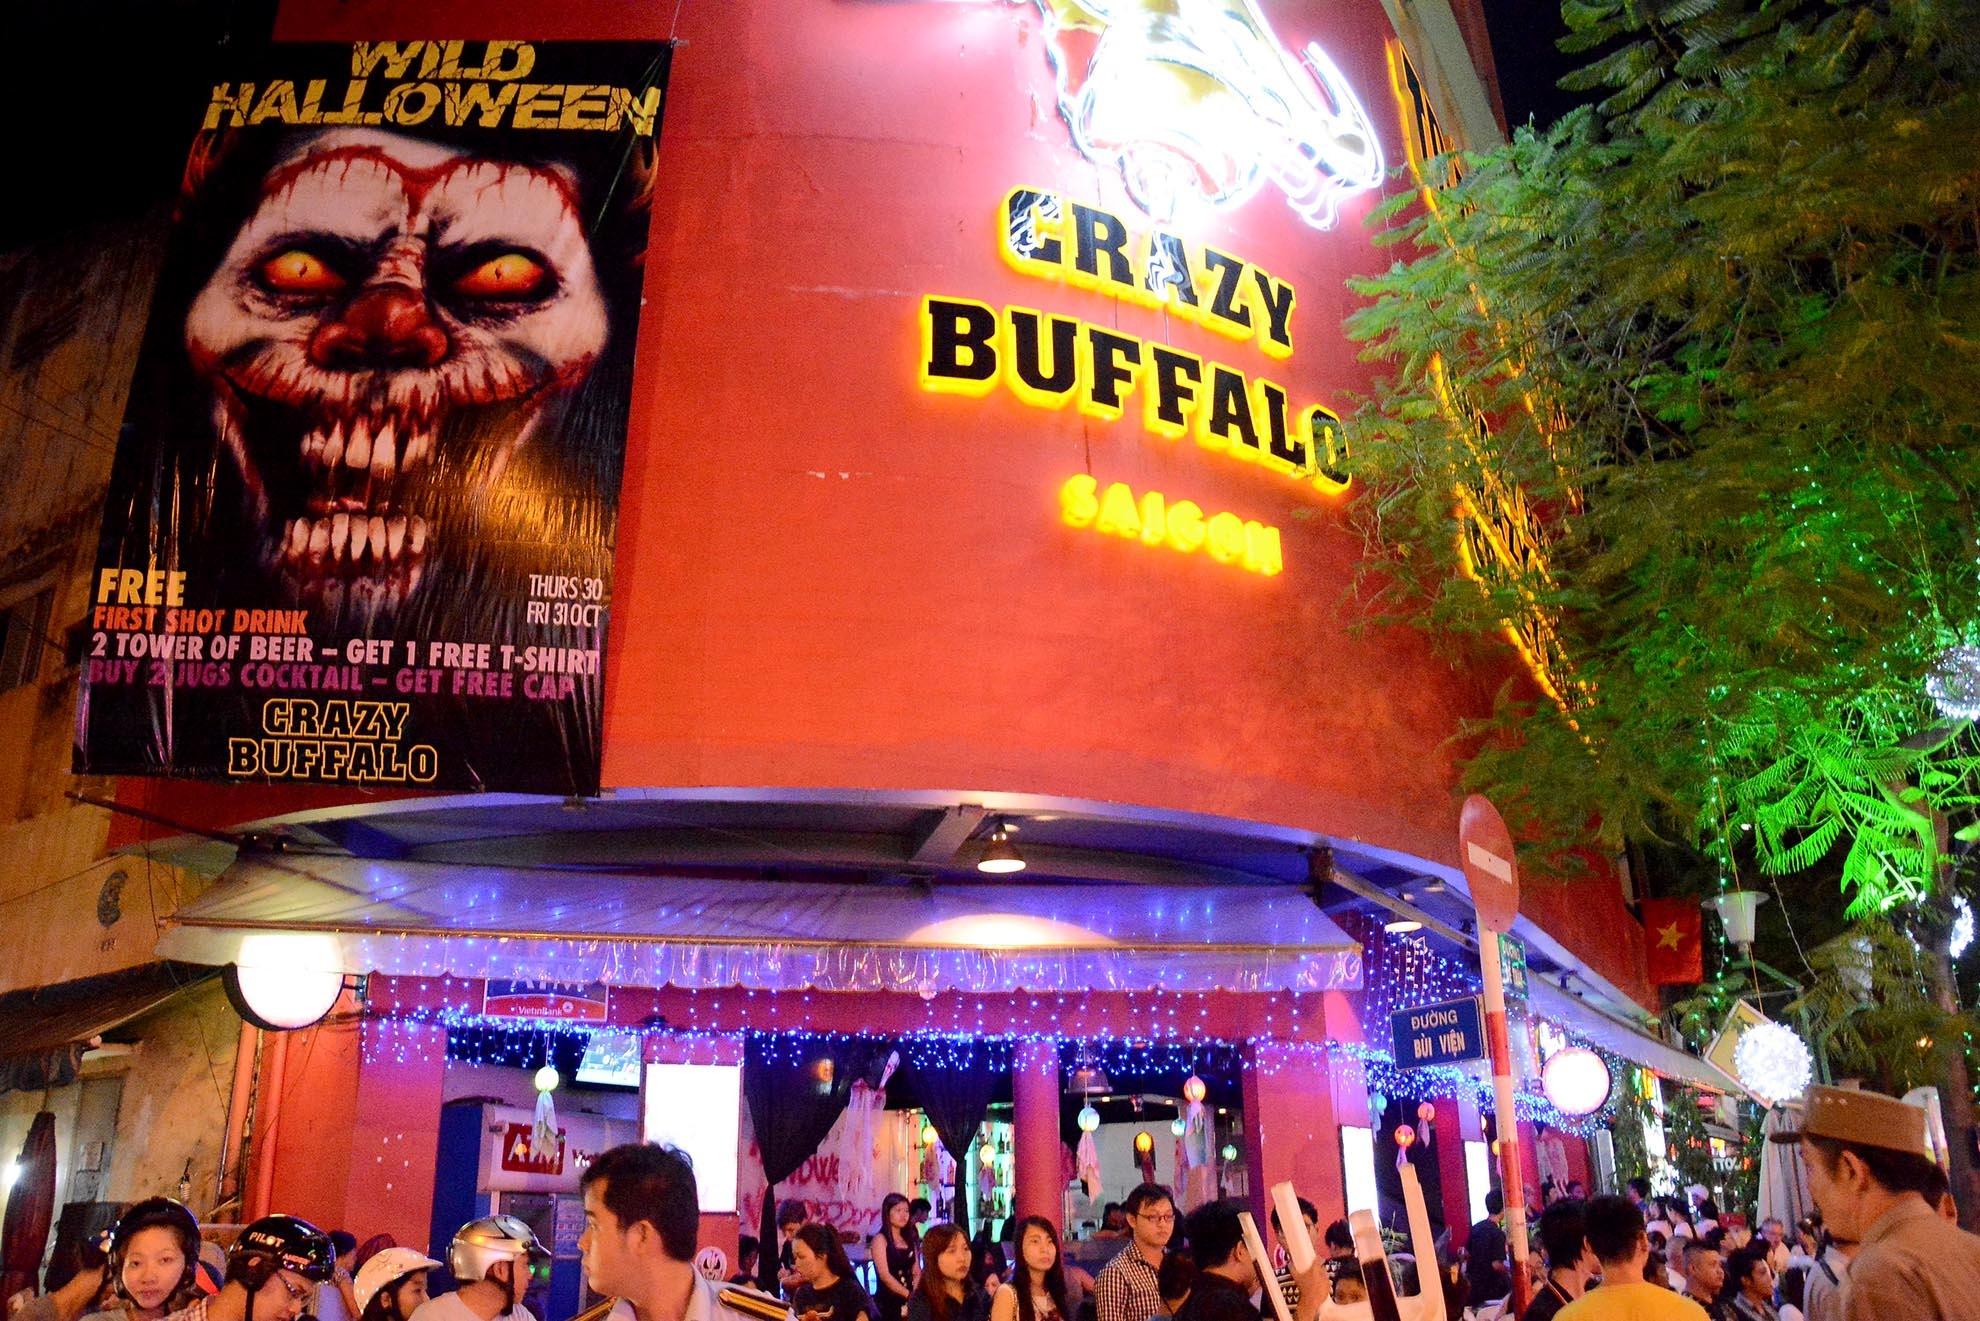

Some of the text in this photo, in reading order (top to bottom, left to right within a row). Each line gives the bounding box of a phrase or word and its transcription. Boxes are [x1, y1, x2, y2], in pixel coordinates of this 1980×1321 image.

[351, 40, 536, 80] WILD
[202, 79, 661, 136] HALLOWEEN
[999, 186, 1296, 358] CRAZY
[922, 294, 1352, 494] BUFFALO
[97, 569, 187, 606] FREE
[529, 574, 603, 600] THURS 30
[93, 606, 308, 635] FIRST SHOT DRINK
[526, 601, 550, 625] FRI
[91, 632, 106, 657] 2
[116, 632, 203, 660] TOWER
[210, 635, 240, 660] OF
[250, 636, 313, 662] BEER
[346, 638, 394, 665] GET
[406, 641, 416, 665] 1
[429, 642, 490, 669] FREE
[501, 645, 600, 674] T-SHIRT
[89, 659, 139, 684] BUY
[148, 661, 166, 686] 2
[175, 662, 231, 687] JUGS
[240, 663, 362, 691] COCKTAIL
[396, 668, 443, 695] GET
[452, 670, 513, 698] FREE
[523, 674, 575, 700] CAP
[262, 698, 409, 740] CRAZY
[228, 737, 438, 782] BUFFALO
[1411, 1009, 1458, 1030] ĐƯỜNG
[1414, 1030, 1466, 1059] BÙI VIỆN
[249, 1231, 285, 1248] PILOT
